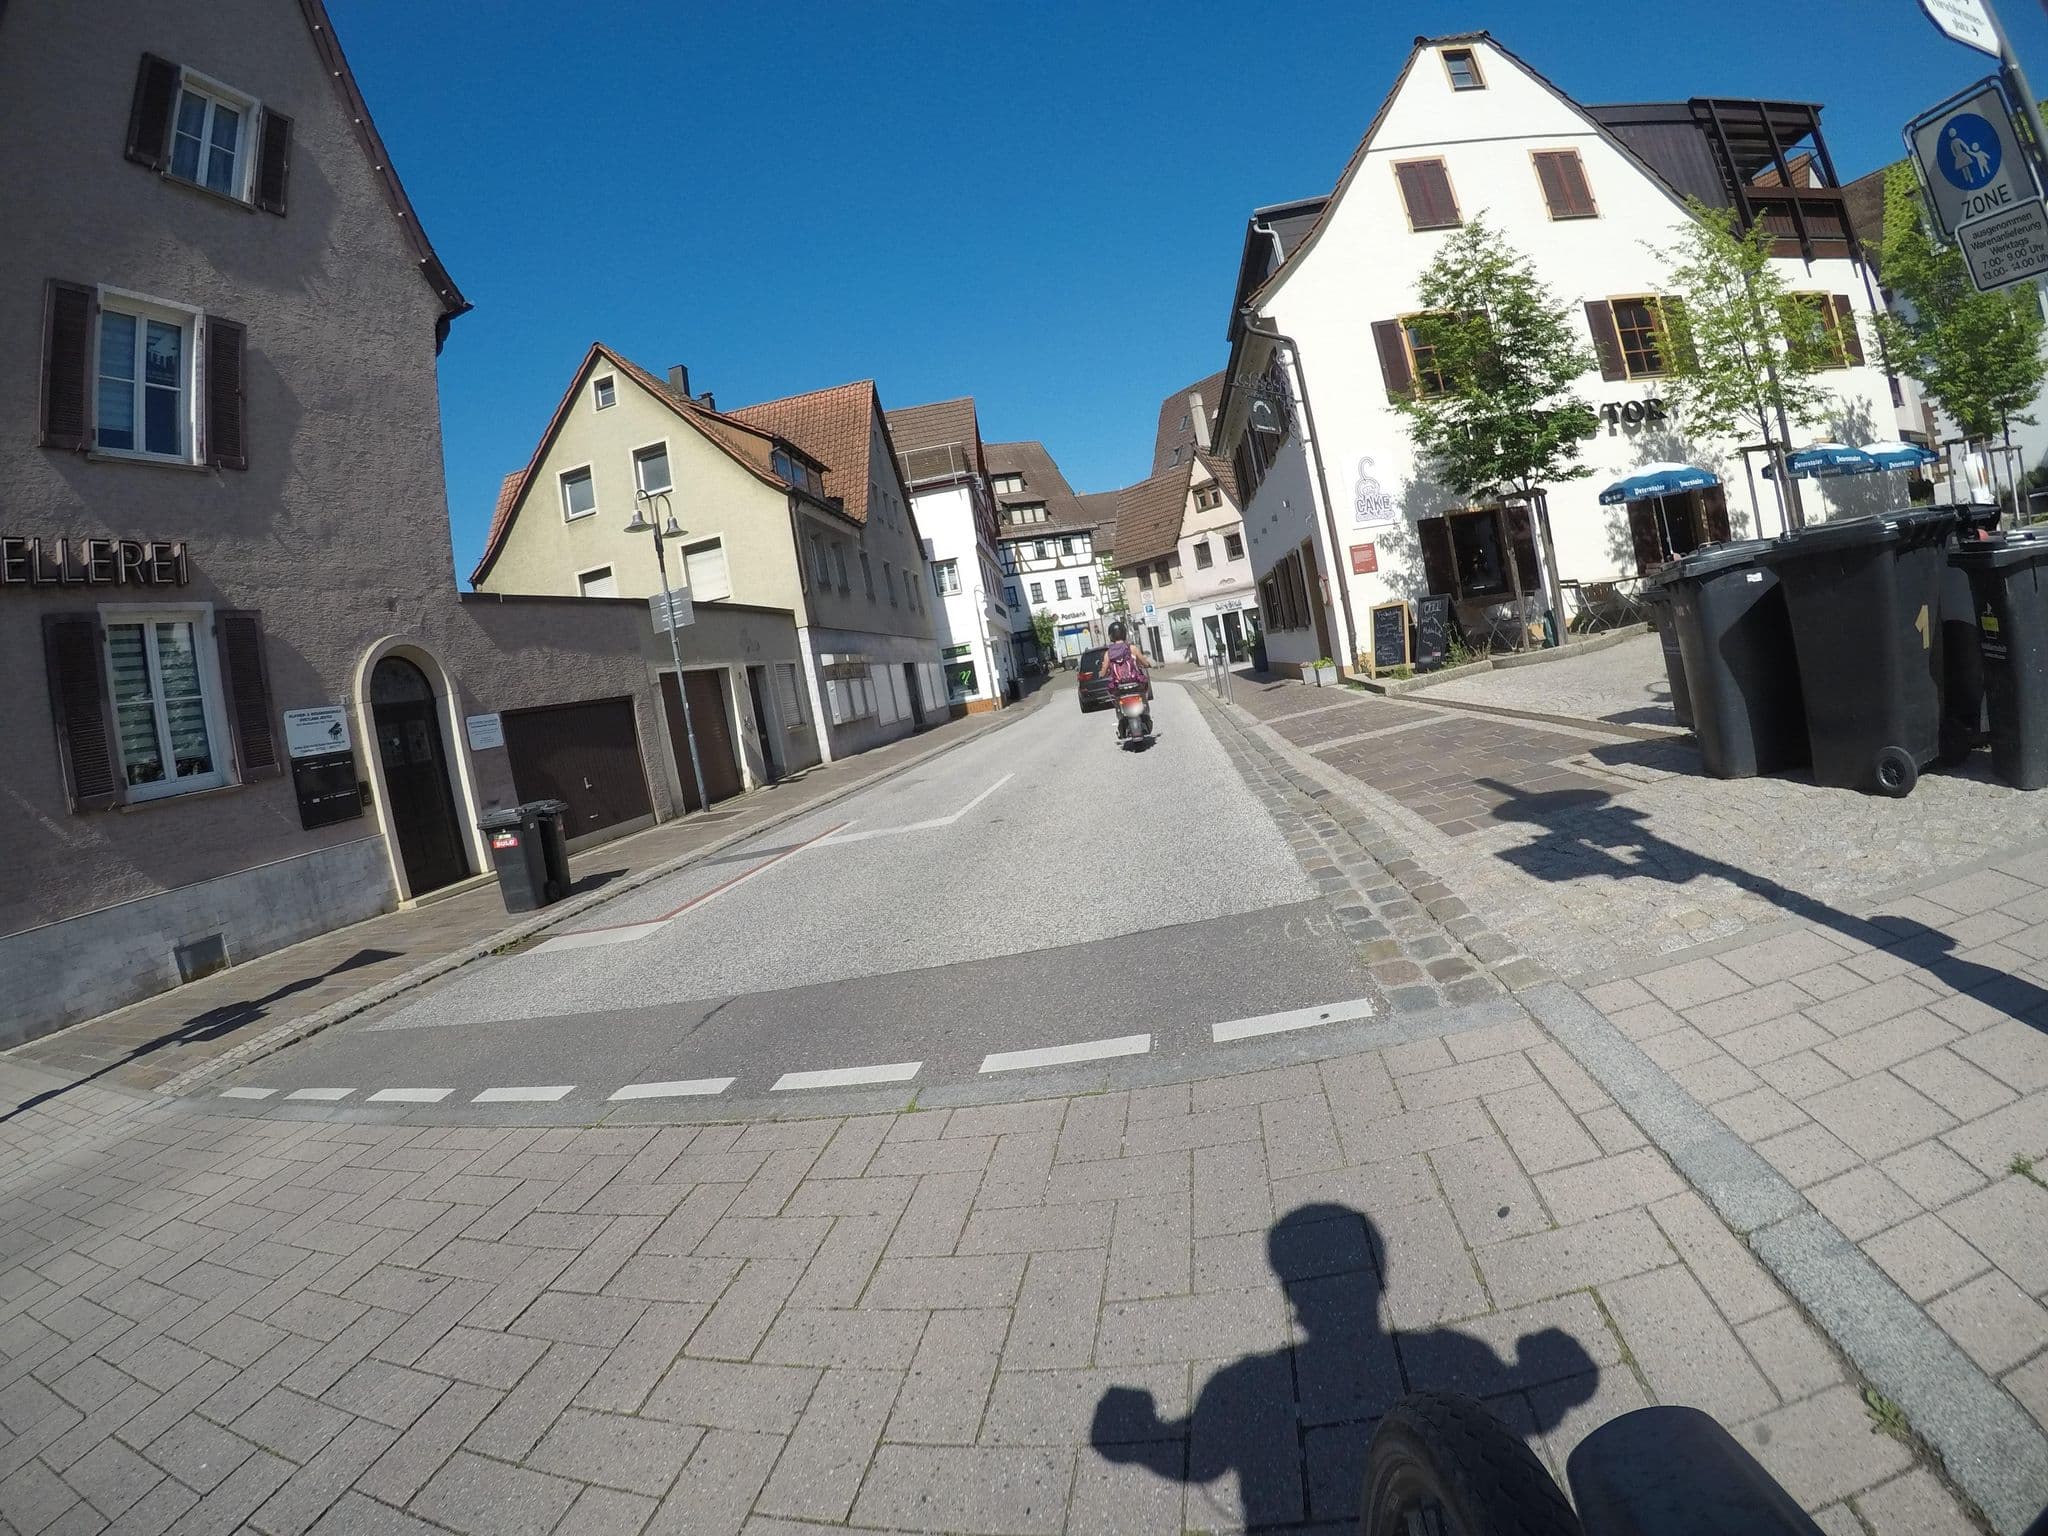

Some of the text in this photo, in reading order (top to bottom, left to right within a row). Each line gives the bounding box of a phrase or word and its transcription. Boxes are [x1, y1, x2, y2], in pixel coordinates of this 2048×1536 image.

[1961, 183, 2012, 219] ZONE
[1970, 221, 2042, 251] Warenanlieferung
[1972, 212, 2033, 240] ausgenommen
[1990, 237, 2030, 256] Werktags
[1356, 495, 1391, 513] CAKE
[1, 536, 190, 585] ELLEREI
[1061, 610, 1087, 620] Postbank
[1914, 604, 1930, 650] 1
